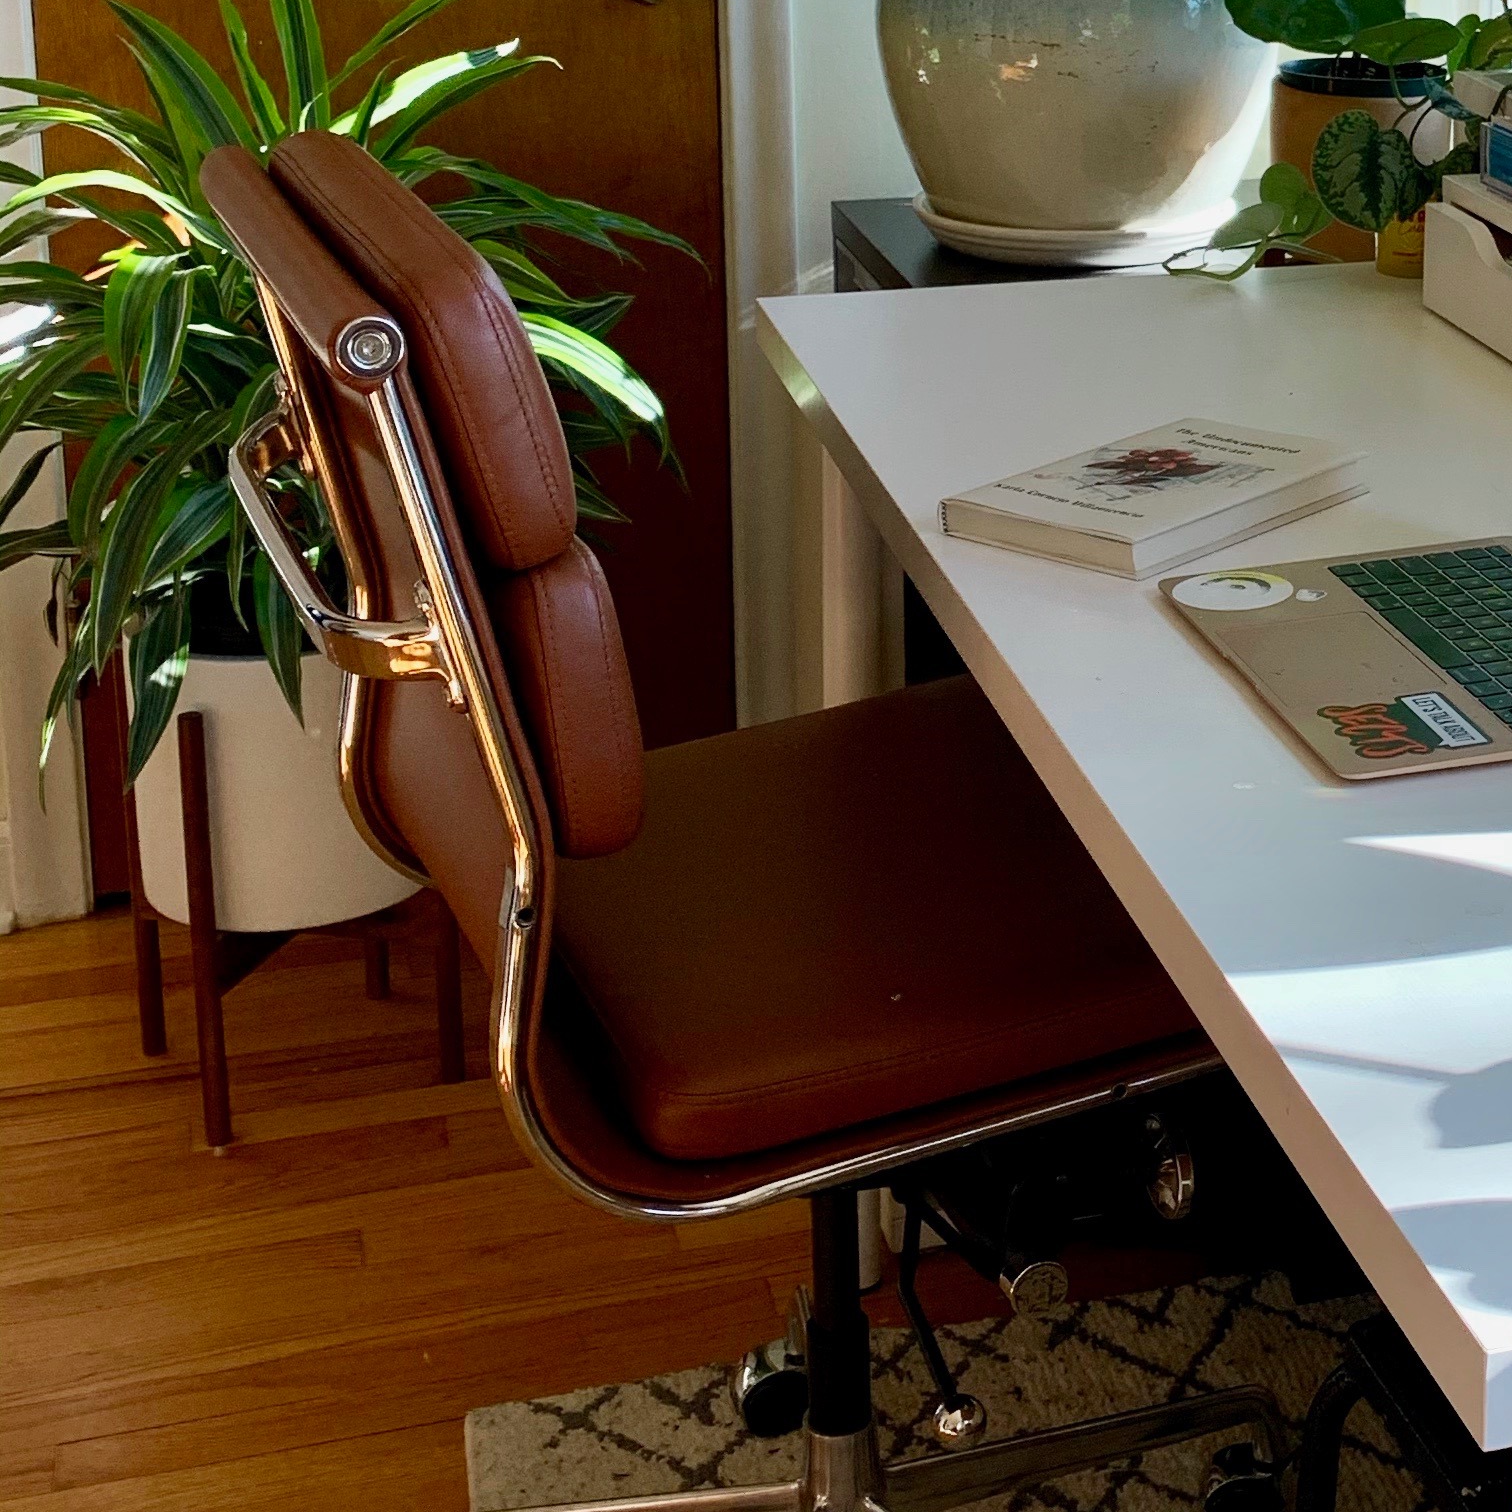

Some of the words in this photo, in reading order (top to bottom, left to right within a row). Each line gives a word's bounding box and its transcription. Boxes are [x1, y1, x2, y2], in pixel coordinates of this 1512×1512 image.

[1411, 696, 1443, 714] LET'S
[1427, 709, 1456, 726] TALK
[1441, 721, 1476, 742] ABOUT
